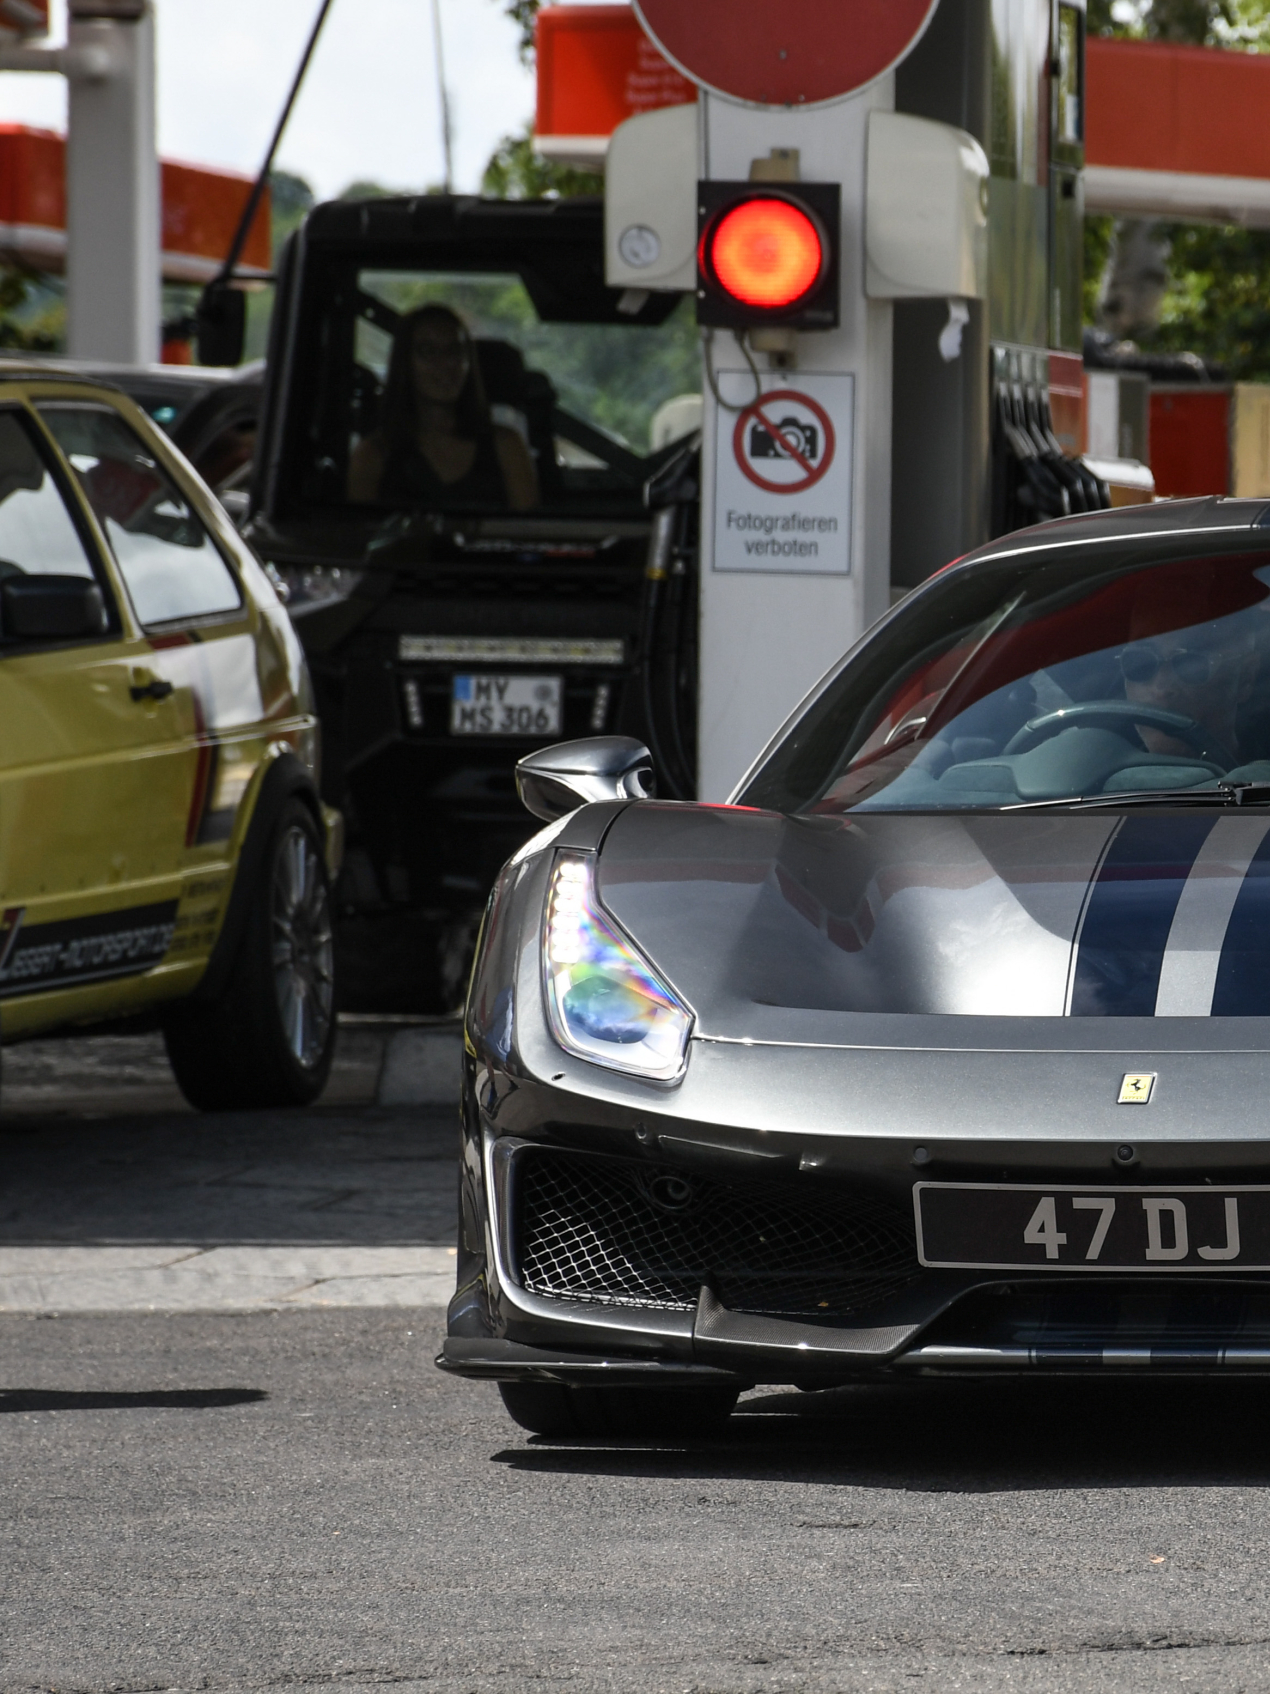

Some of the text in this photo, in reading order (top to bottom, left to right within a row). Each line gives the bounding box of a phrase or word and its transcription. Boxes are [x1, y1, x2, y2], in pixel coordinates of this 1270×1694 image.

[727, 509, 839, 535] Fotografieren
[744, 539, 819, 557] verboten
[501, 704, 550, 732] 306
[1024, 1197, 1240, 1261] 47 DJ
